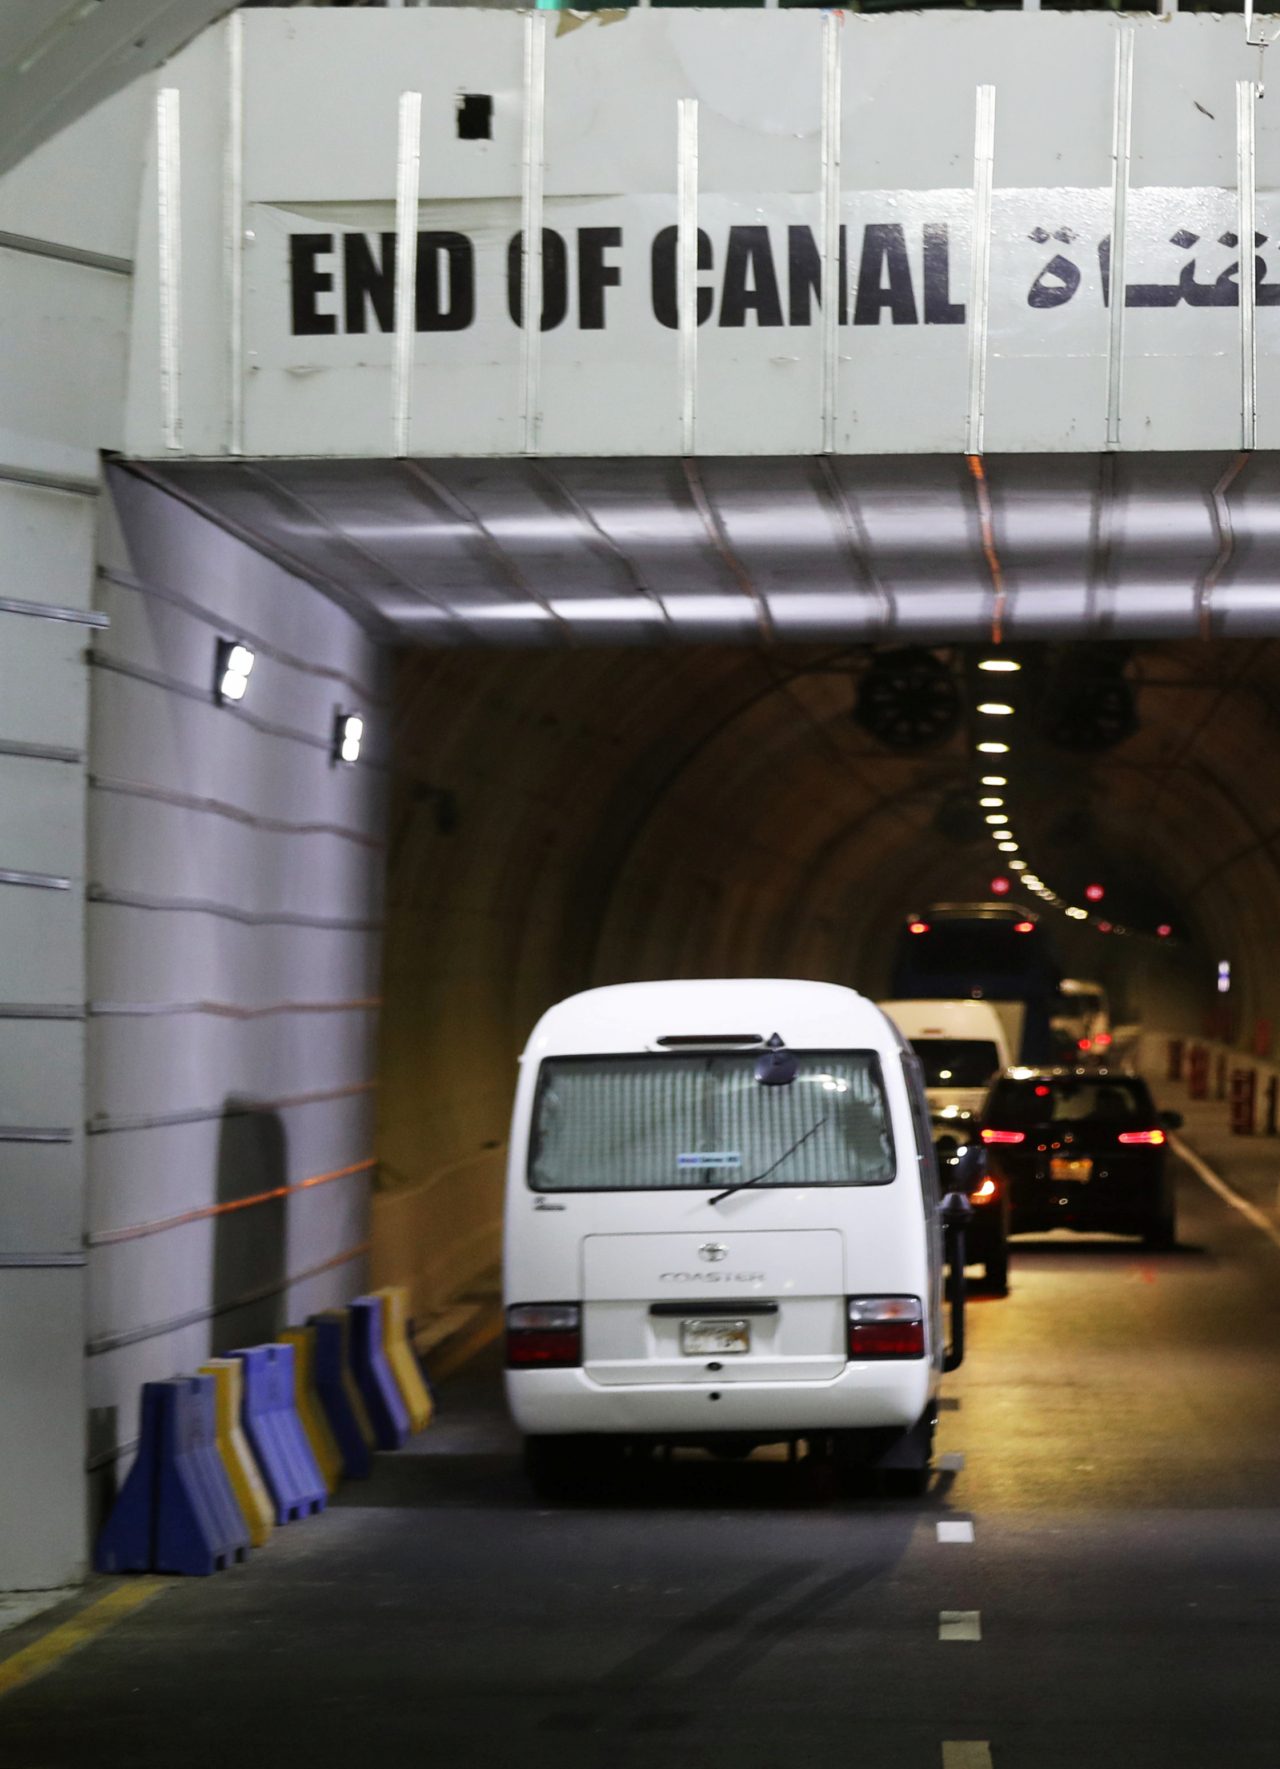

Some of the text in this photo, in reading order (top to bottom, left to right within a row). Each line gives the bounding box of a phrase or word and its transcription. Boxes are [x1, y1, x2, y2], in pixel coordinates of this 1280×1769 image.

[290, 223, 966, 336] END OF CANAL
